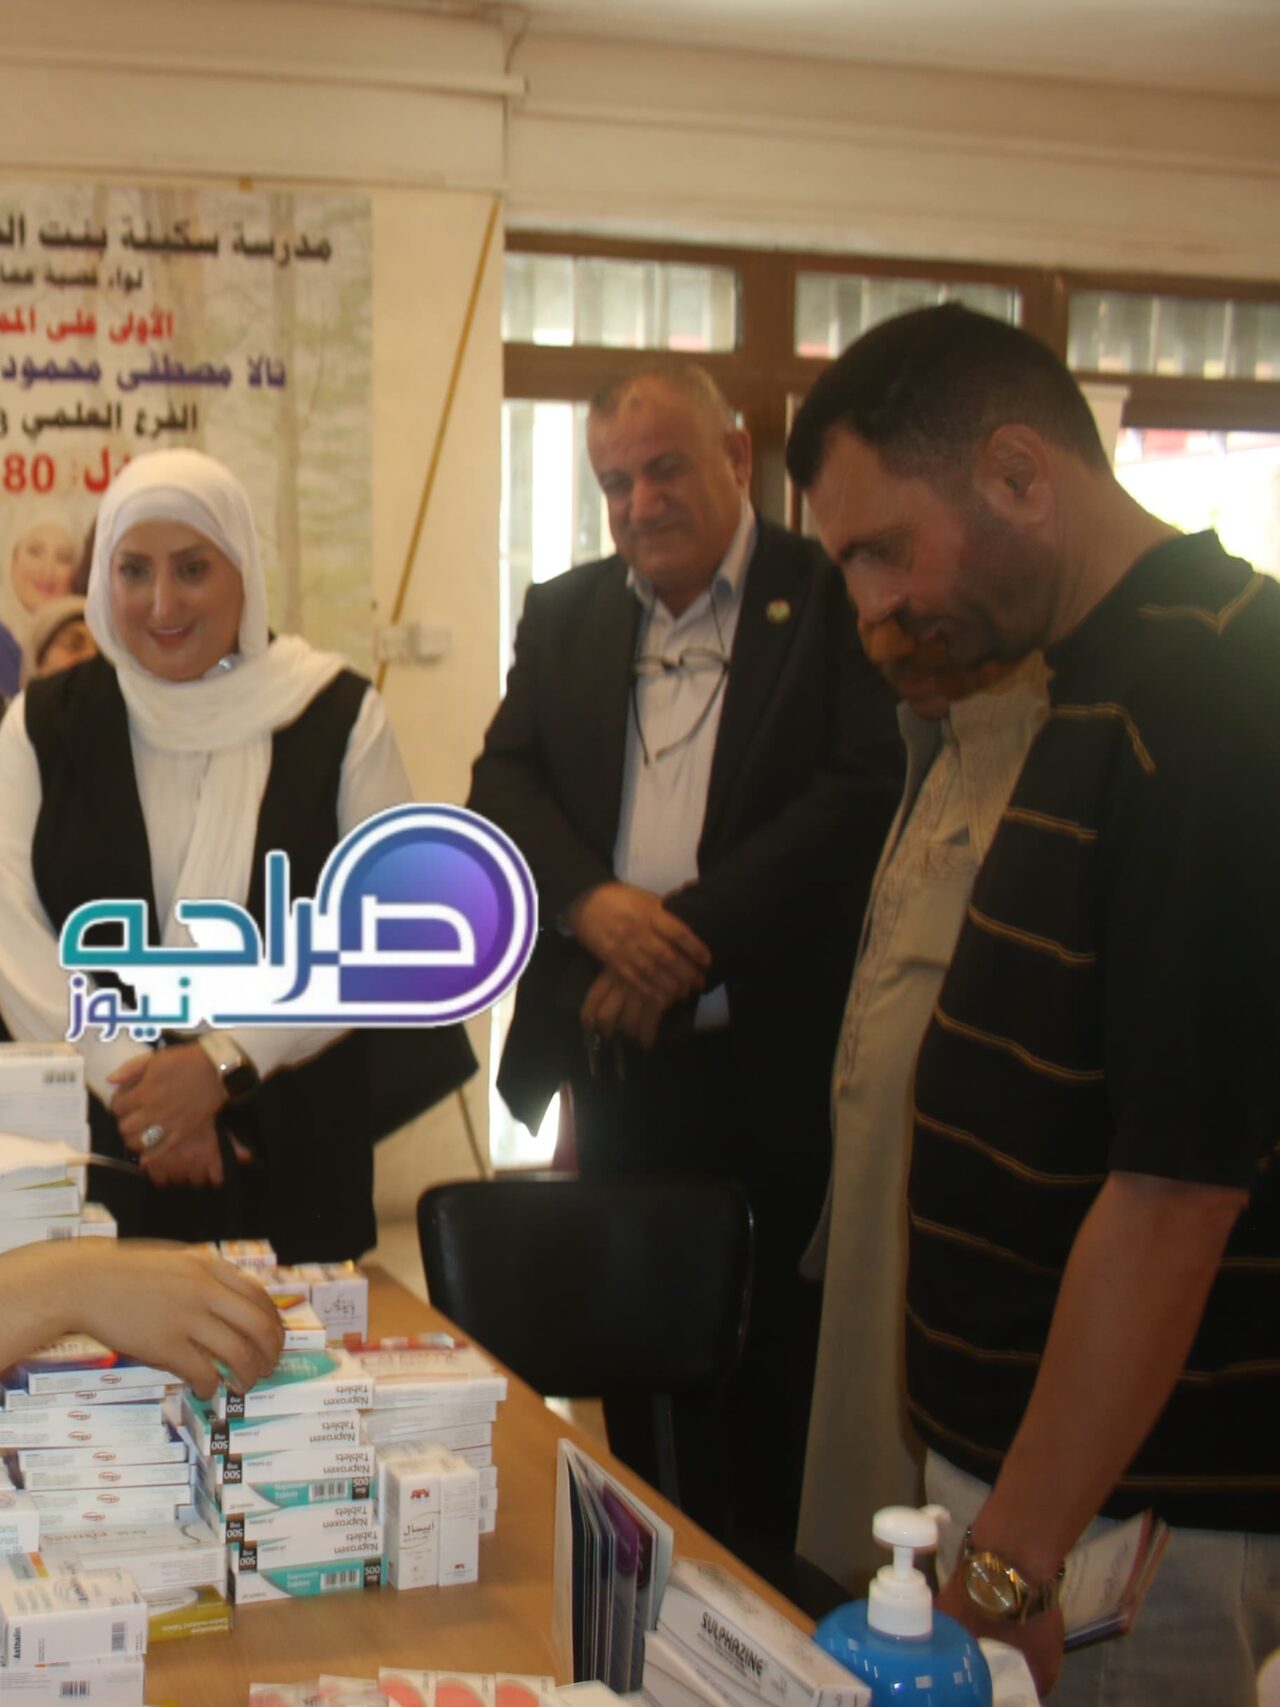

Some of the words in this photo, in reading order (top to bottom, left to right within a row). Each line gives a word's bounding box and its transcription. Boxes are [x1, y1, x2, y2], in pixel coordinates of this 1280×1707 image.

[38, 219, 108, 259] بنت
[121, 214, 218, 259] سكينة
[232, 220, 332, 268] مدرسة
[46, 307, 97, 342] على
[108, 303, 174, 344] الأولى
[1, 355, 101, 390] محمود
[116, 350, 232, 392] مصطفى
[21, 400, 122, 446] العلمي
[134, 400, 197, 439] الفرع
[336, 1384, 369, 1393] Tablets
[323, 1396, 369, 1406] Naproxen
[226, 1404, 244, 1413] 500
[321, 1420, 355, 1430] Tablets
[309, 1433, 356, 1443] Naproxen
[211, 1441, 229, 1450] 500
[335, 1453, 369, 1462] Tablets
[323, 1464, 370, 1474] Naproxen
[223, 1471, 241, 1480] 500
[334, 1507, 368, 1516] Tablets
[322, 1518, 369, 1528] Naproxen
[226, 1529, 244, 1538] 500
[345, 1531, 378, 1540] Tablets
[334, 1543, 379, 1553] Naproxen
[239, 1557, 257, 1566] 500
[13, 1626, 22, 1660] Asthalin
[700, 1611, 765, 1677] SULPHAZINE
